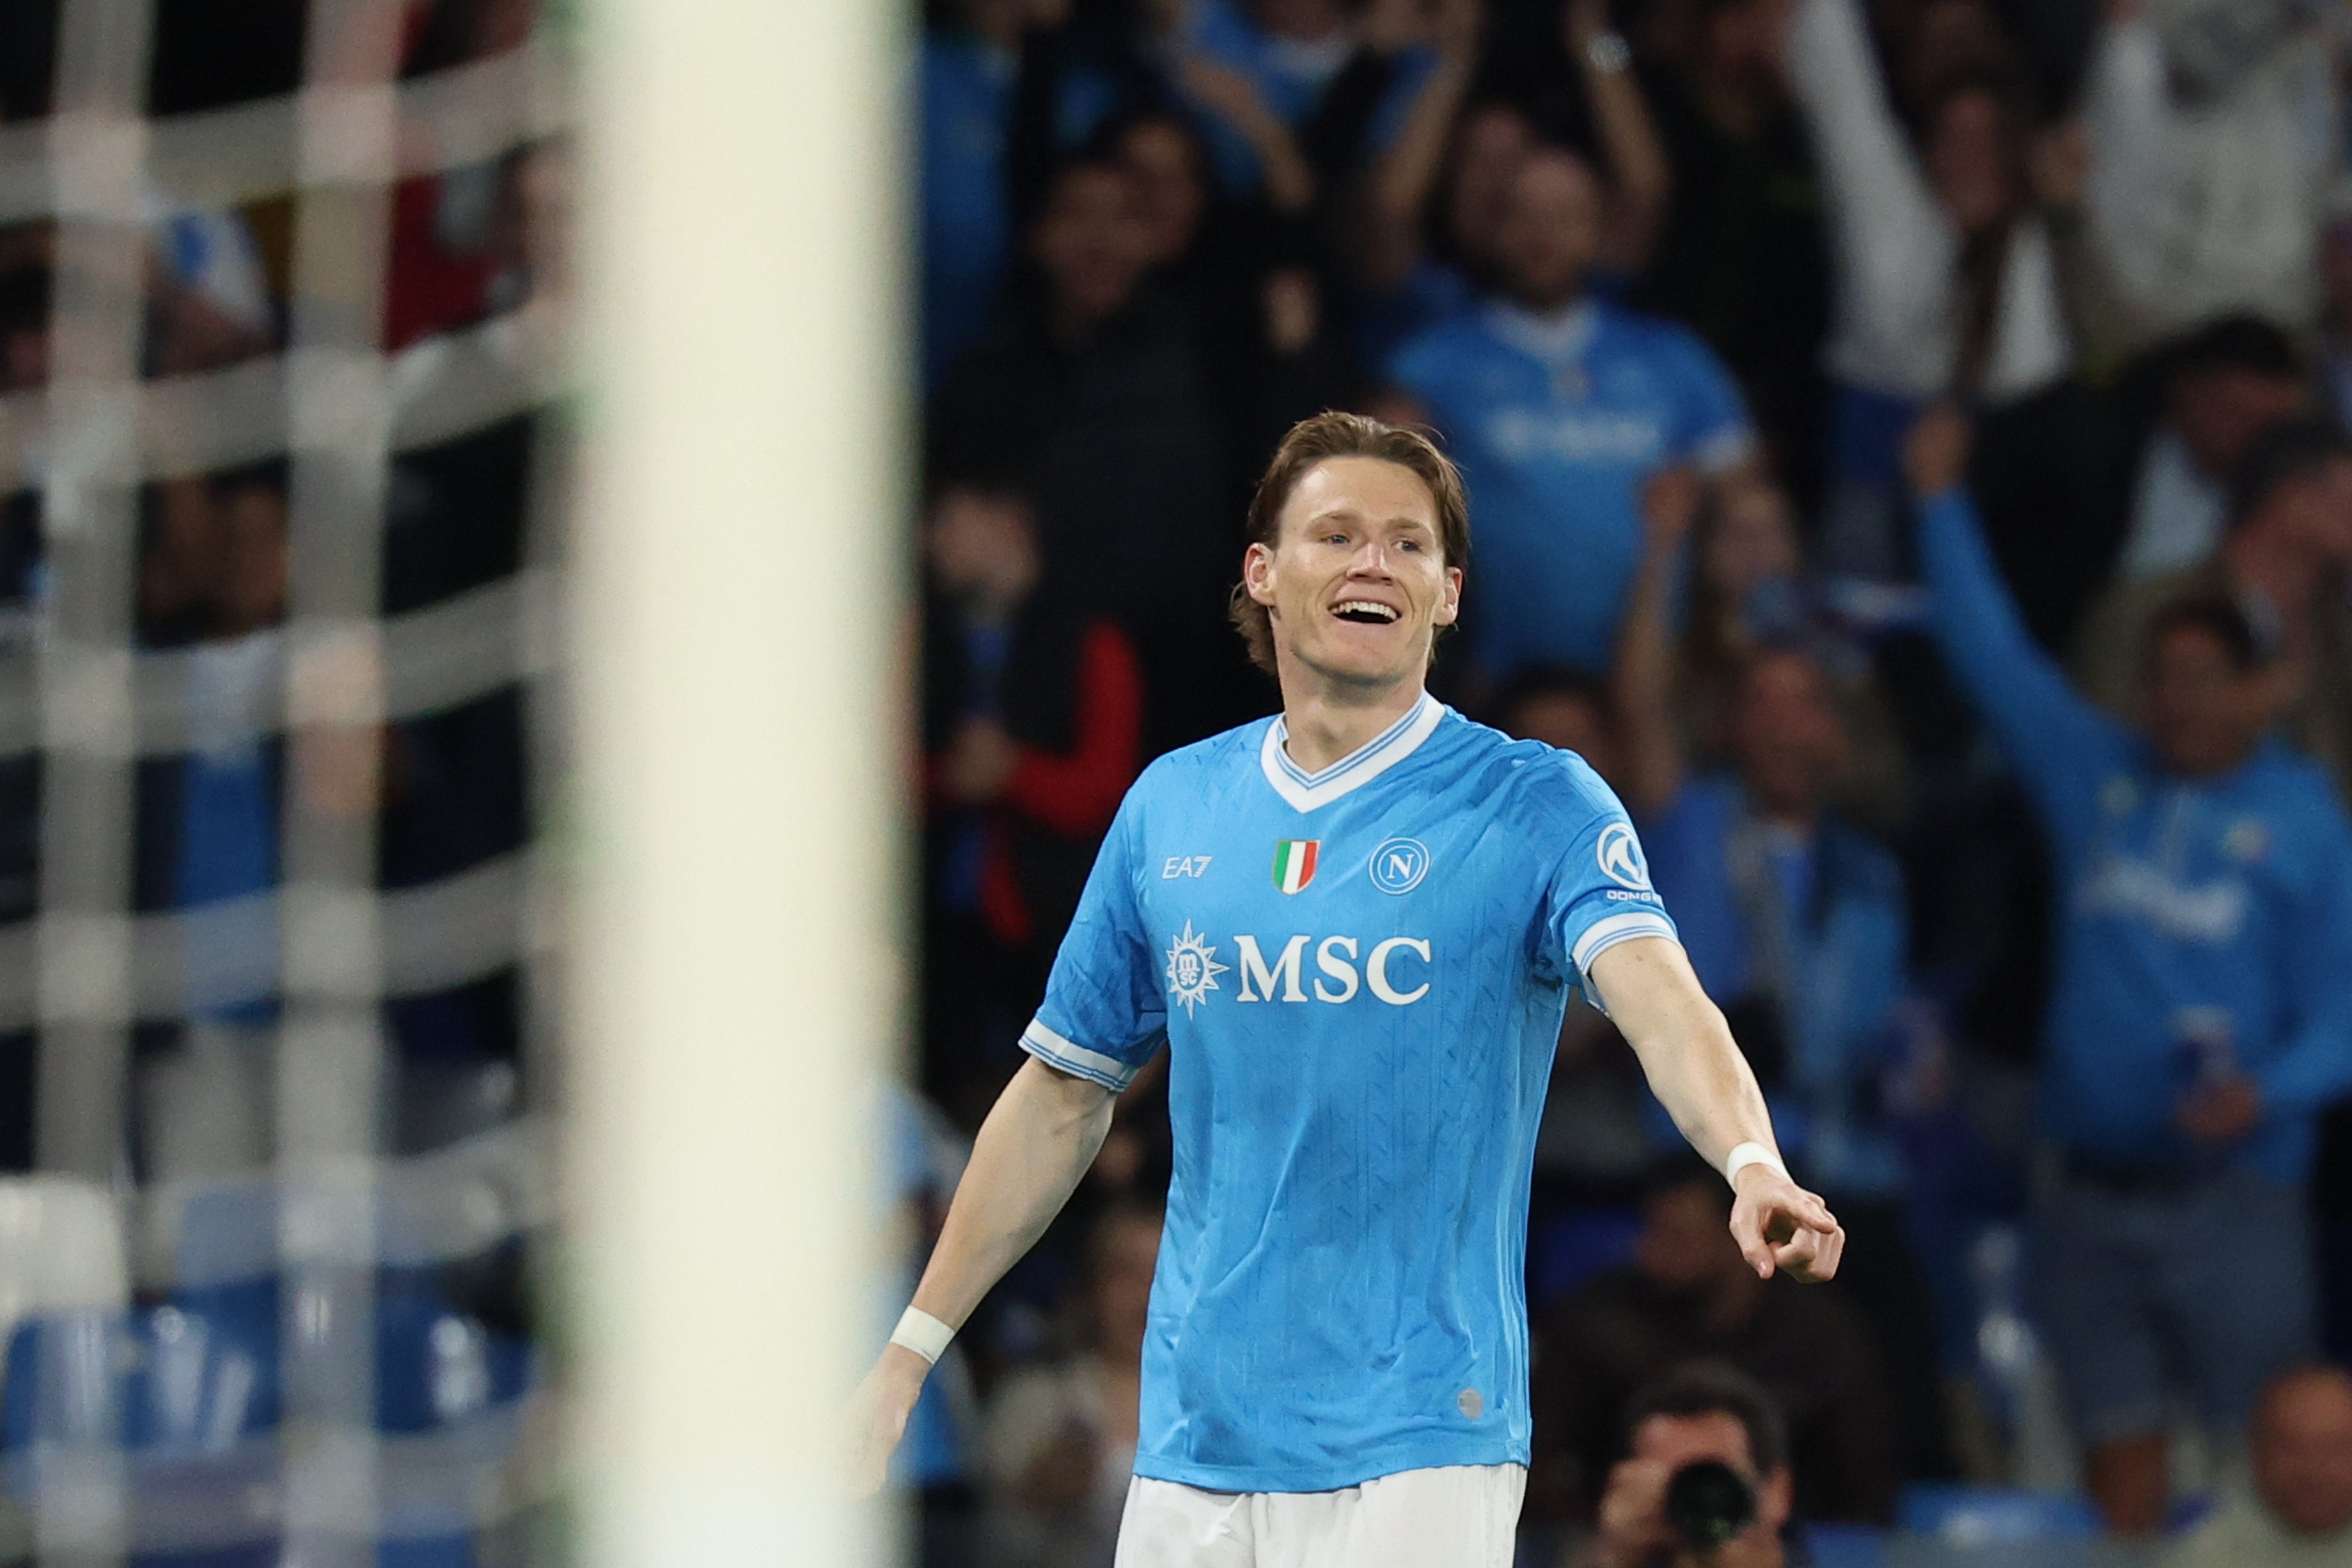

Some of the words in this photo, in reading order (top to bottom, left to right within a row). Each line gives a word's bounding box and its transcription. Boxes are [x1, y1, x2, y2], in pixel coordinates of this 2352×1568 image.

[1163, 856, 1212, 879] EA7
[1387, 854, 1415, 879] N
[1233, 935, 1431, 1005] MSC
